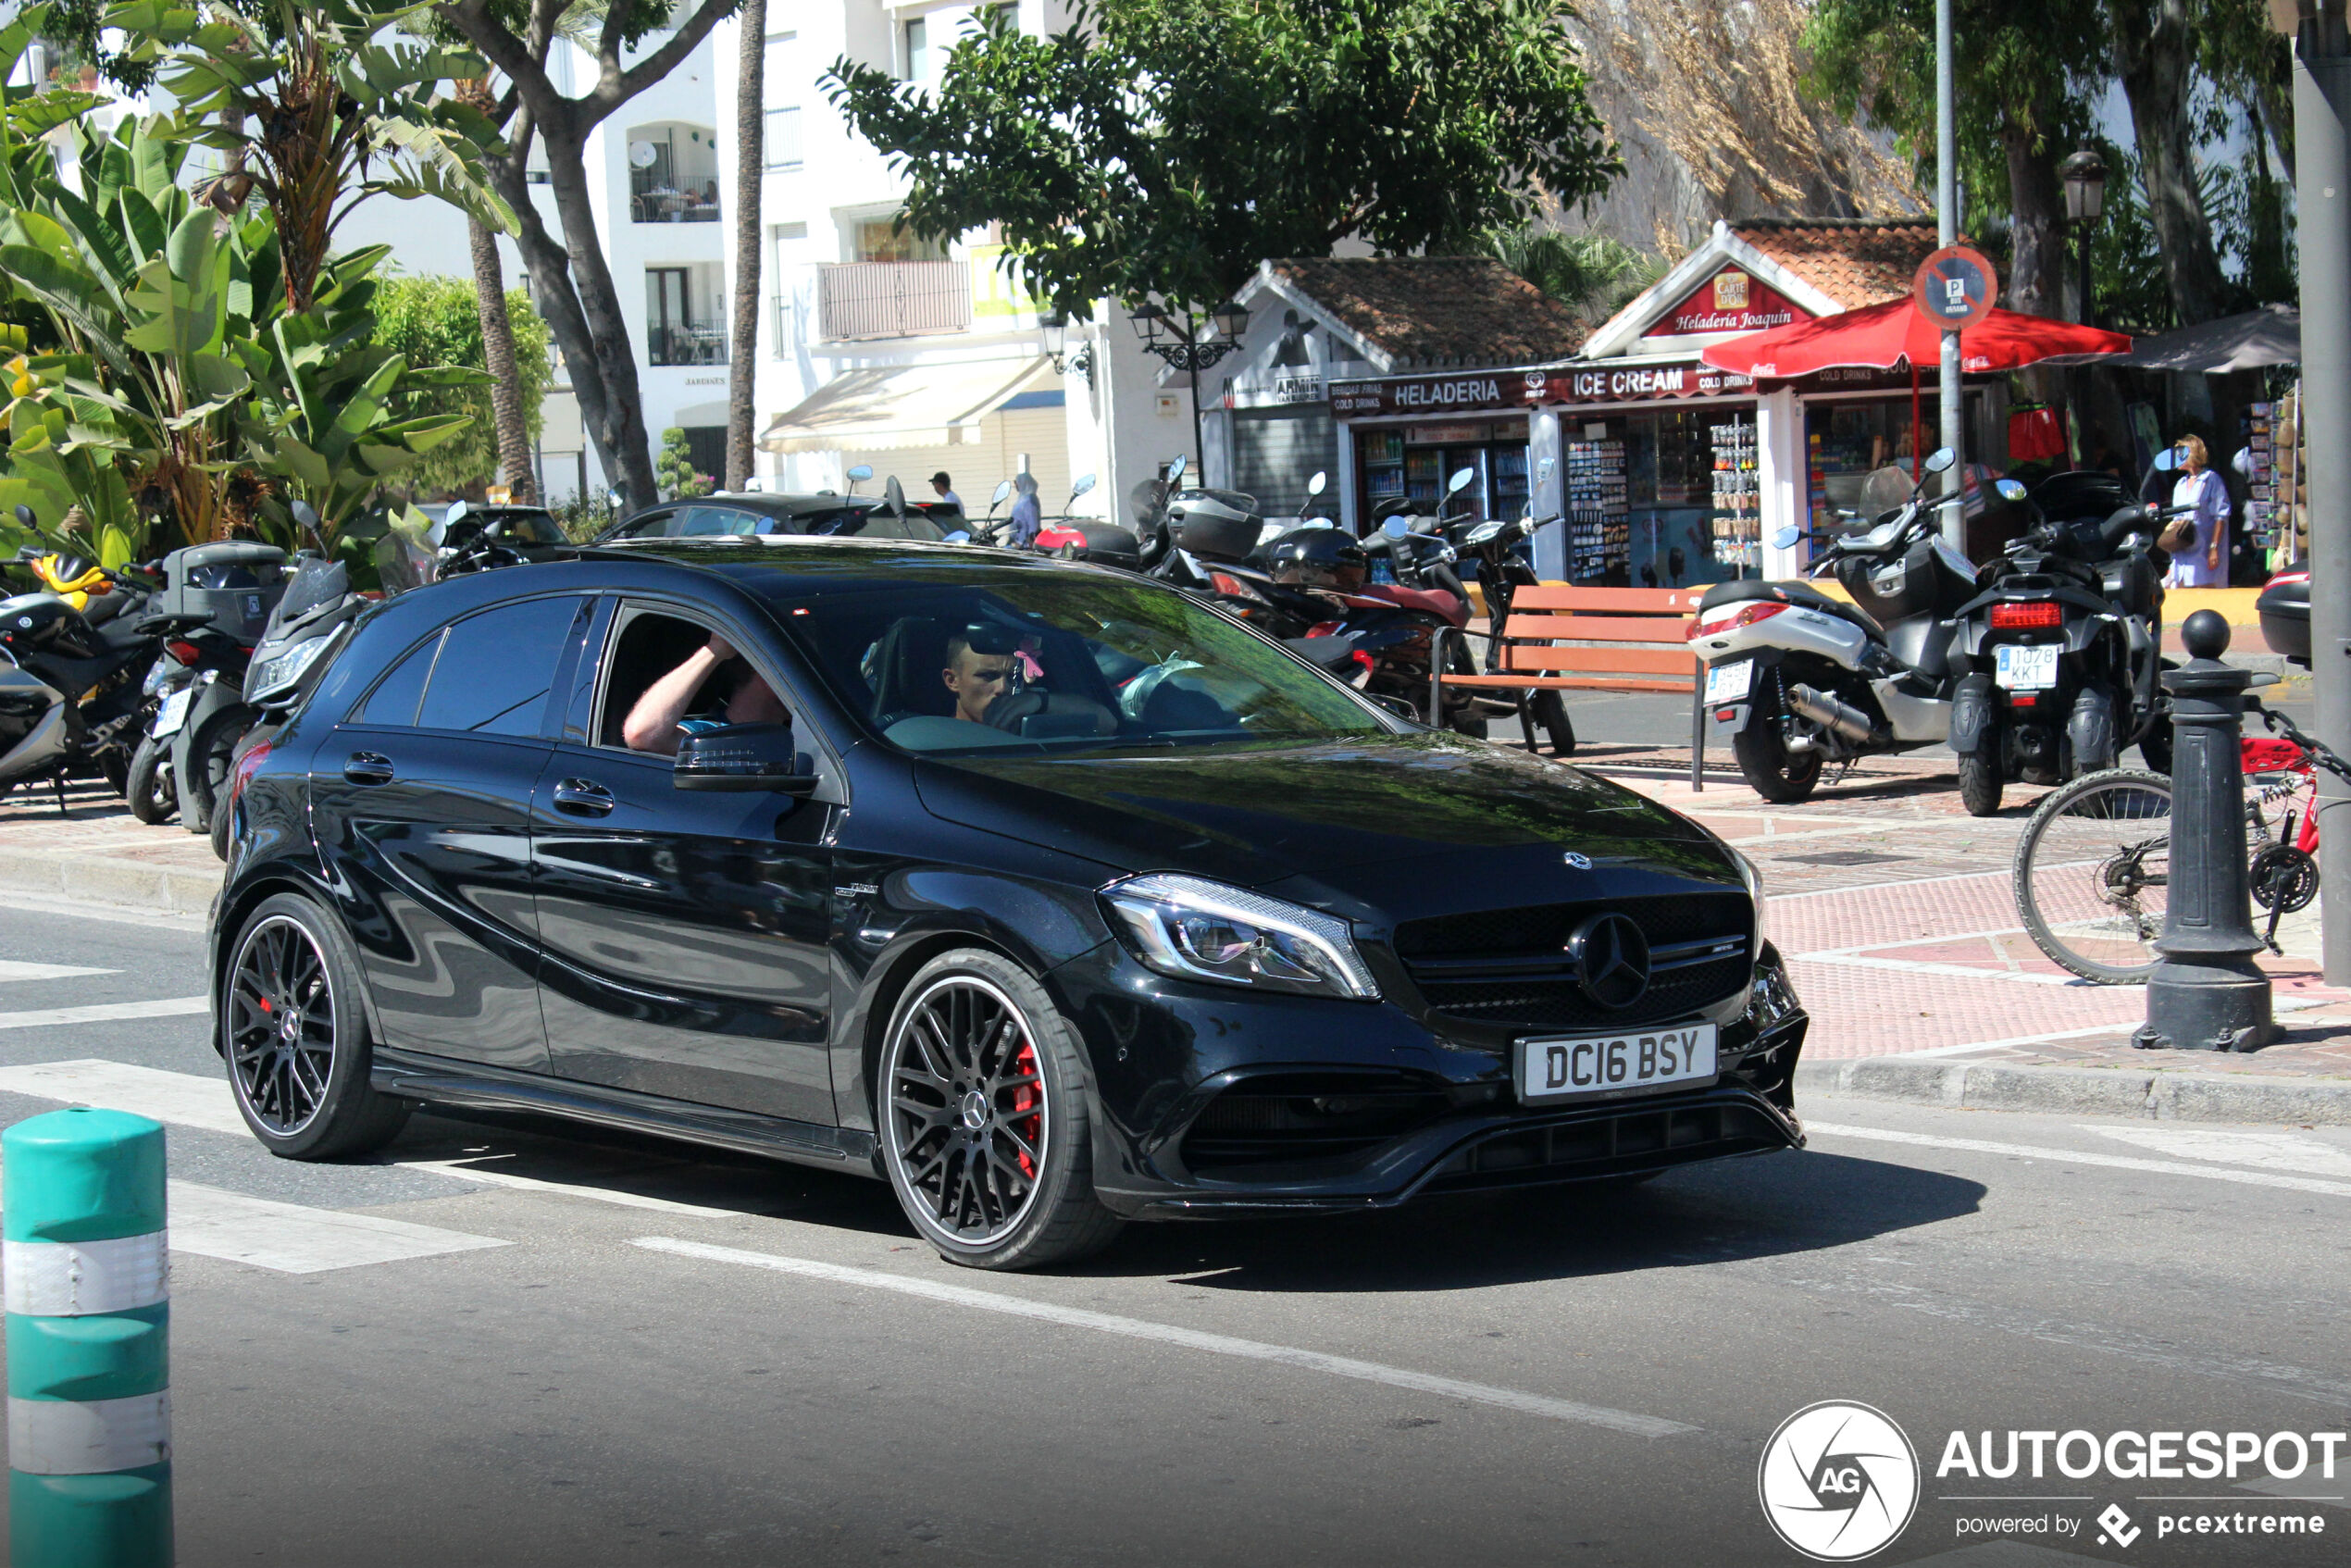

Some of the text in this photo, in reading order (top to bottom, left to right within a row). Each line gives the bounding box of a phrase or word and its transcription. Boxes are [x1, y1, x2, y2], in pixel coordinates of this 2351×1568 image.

[1717, 281, 1746, 293] CARTE
[1951, 281, 1959, 295] P
[1675, 309, 1792, 330] Heladería Joaquín
[685, 377, 726, 385] JARDINES
[1574, 367, 1683, 396] ICE CREAM
[1698, 374, 1753, 389] COLD DRINKS
[1819, 369, 1872, 381] COLD DRINKS
[1277, 379, 1320, 394] ARMIN
[1395, 380, 1500, 406] HELADERIA
[1335, 397, 1380, 410] COLD DRINKS
[2017, 649, 2053, 664] 1078
[2012, 665, 2042, 680] KKT
[1546, 1030, 1698, 1089] DC16 BSY
